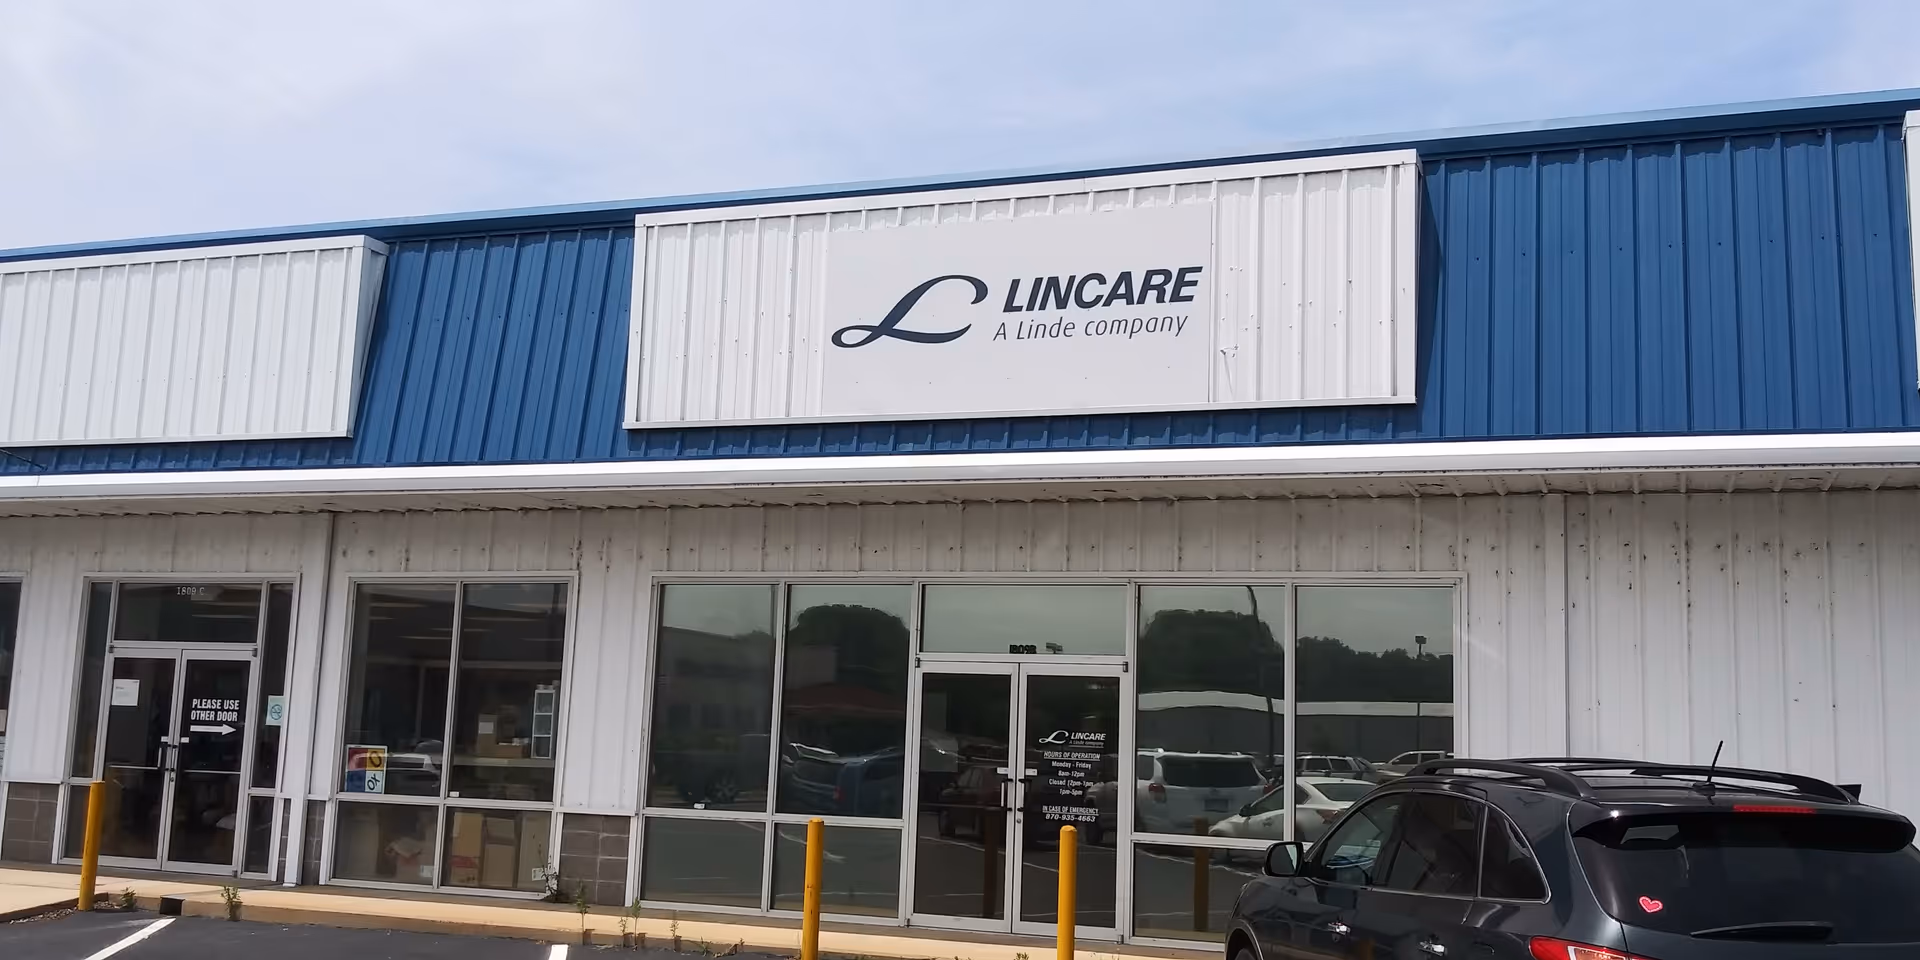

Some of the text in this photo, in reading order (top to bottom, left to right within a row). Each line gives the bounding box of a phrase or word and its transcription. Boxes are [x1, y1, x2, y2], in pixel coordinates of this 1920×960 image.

[1002, 266, 1204, 313] LINCARE
[993, 315, 1188, 341] A Linde company
[177, 586, 197, 596] 1809
[192, 698, 240, 710] PLEASE USE
[190, 710, 238, 722] OTHER DOOR
[1071, 732, 1106, 741] LINCARE
[1071, 752, 1101, 760] OPERATION
[1075, 761, 1092, 770] Friday
[1069, 806, 1099, 814] EMERGENCY
